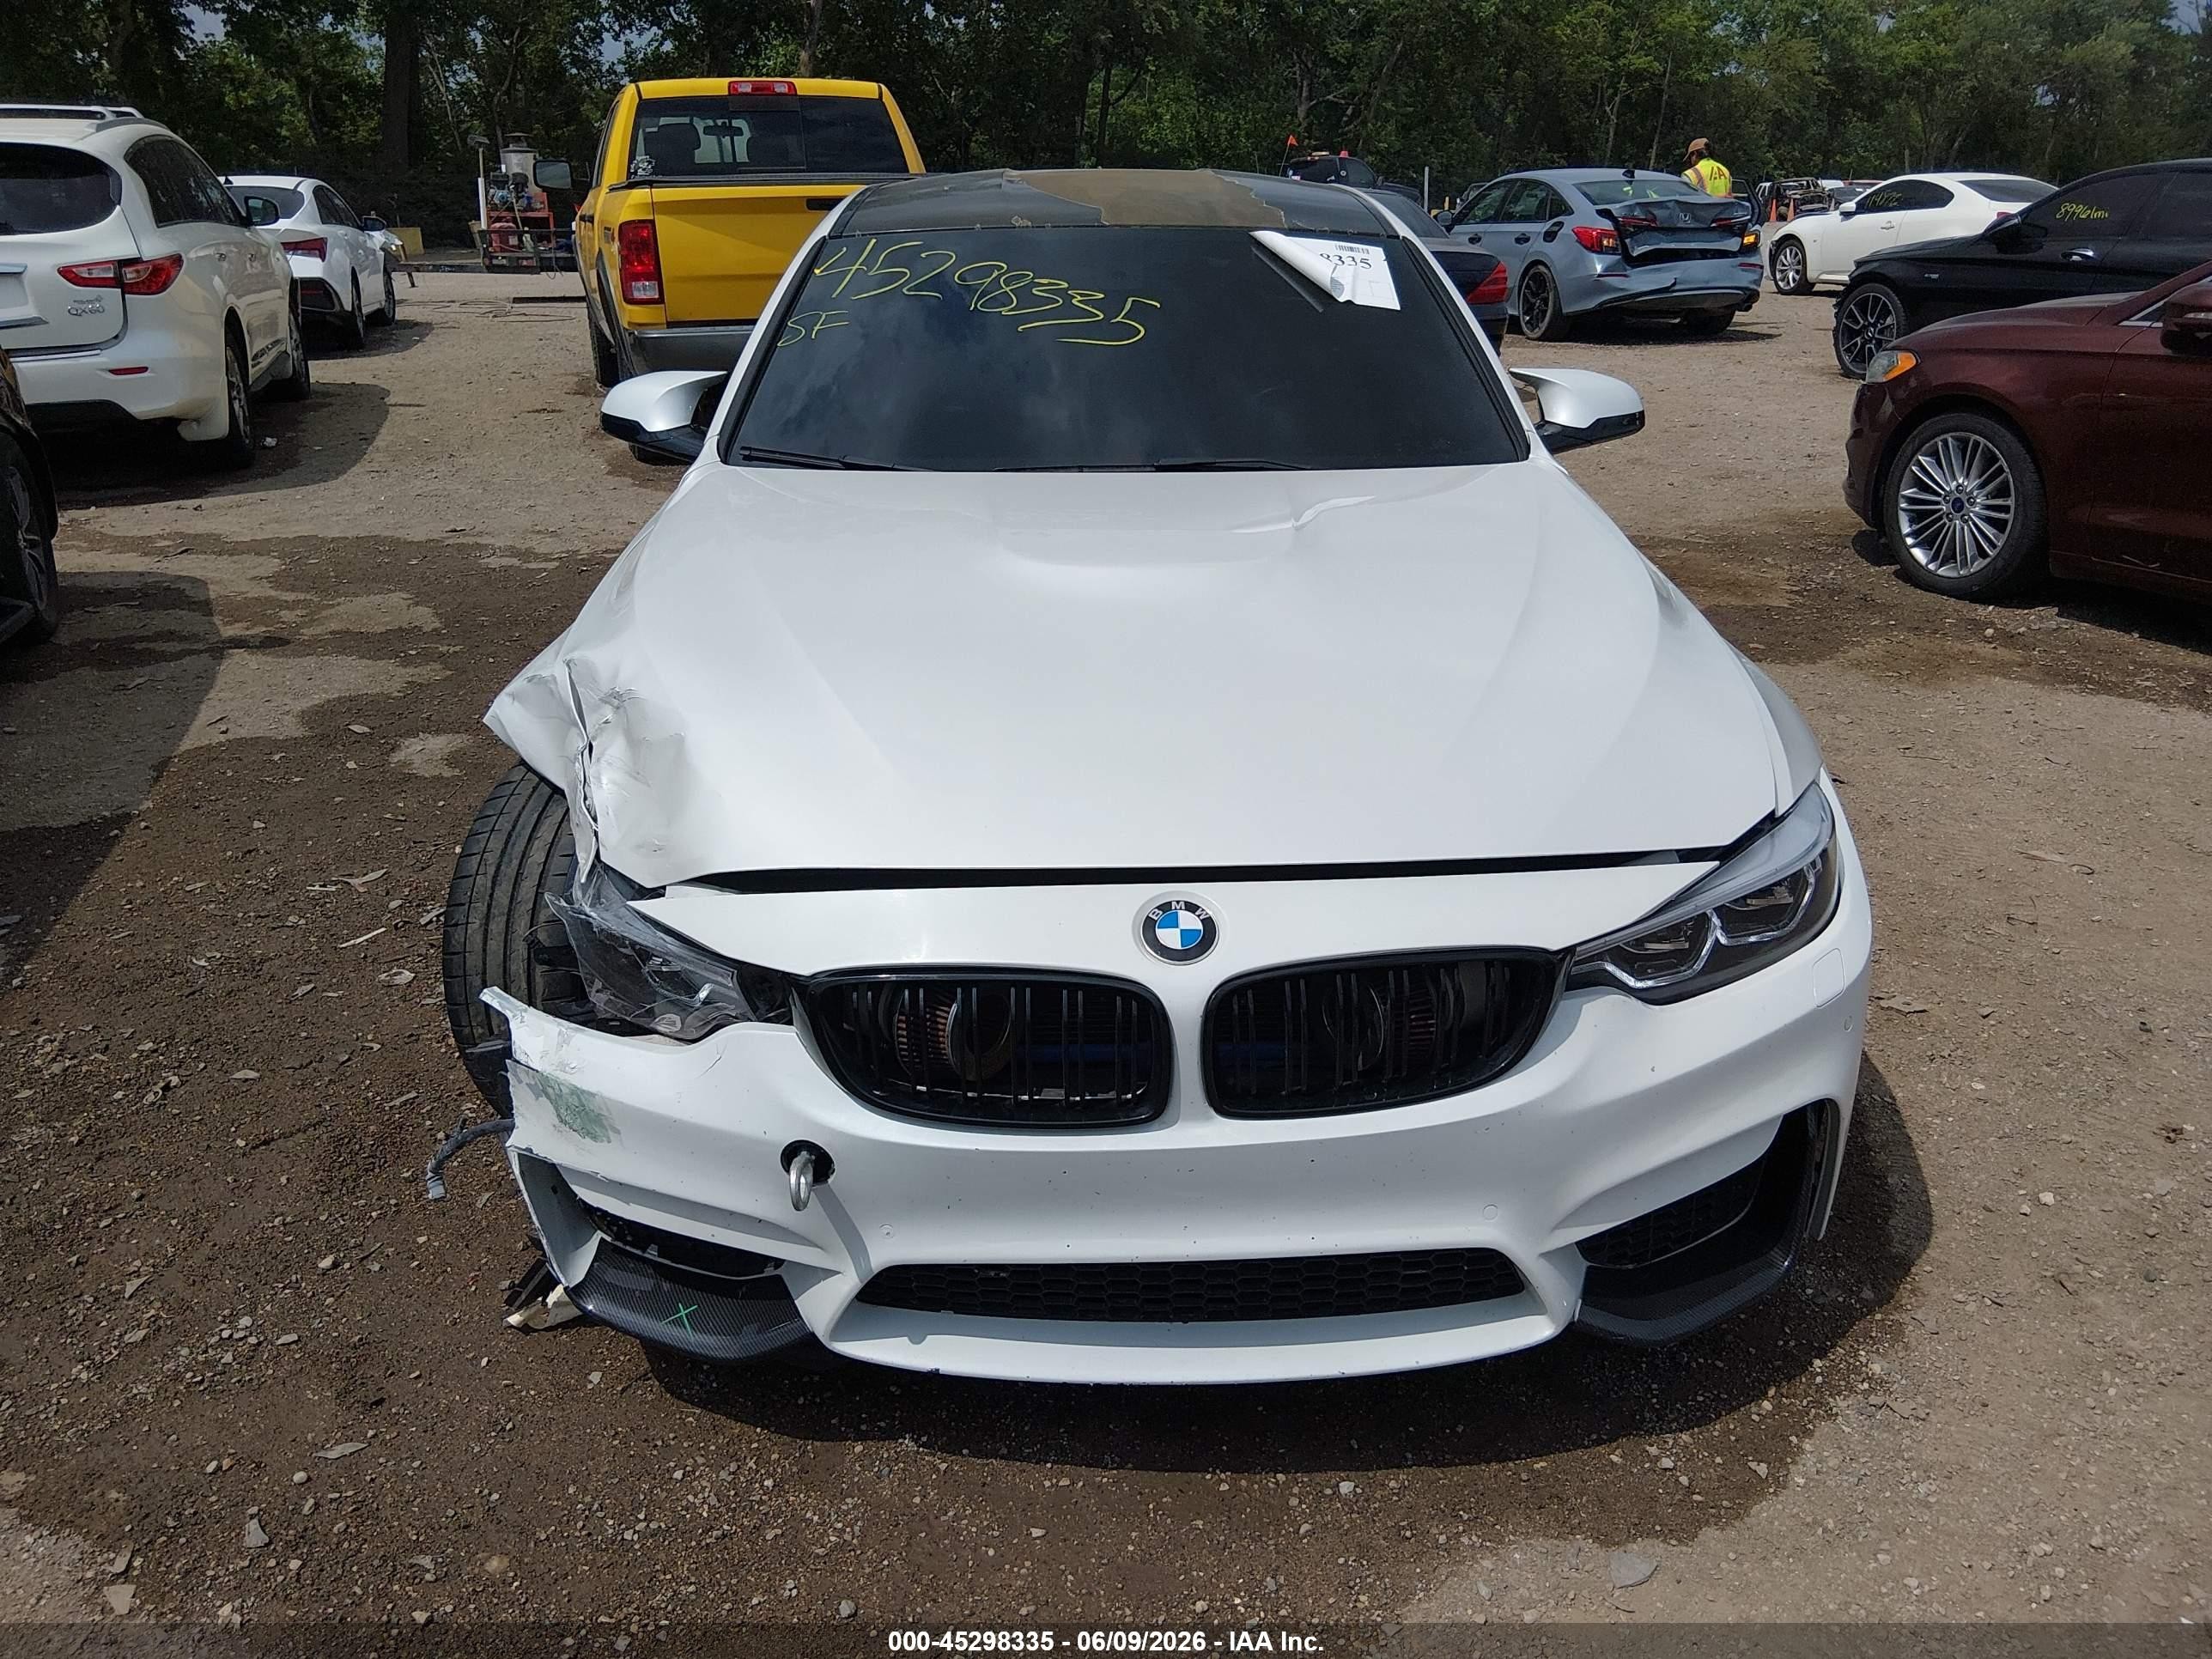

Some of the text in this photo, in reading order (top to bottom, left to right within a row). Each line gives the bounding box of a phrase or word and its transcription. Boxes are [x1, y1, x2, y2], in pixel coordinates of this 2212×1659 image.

[814, 239, 1161, 345] 45298335
[776, 310, 850, 346] SF
[1148, 901, 1210, 921] BMW
